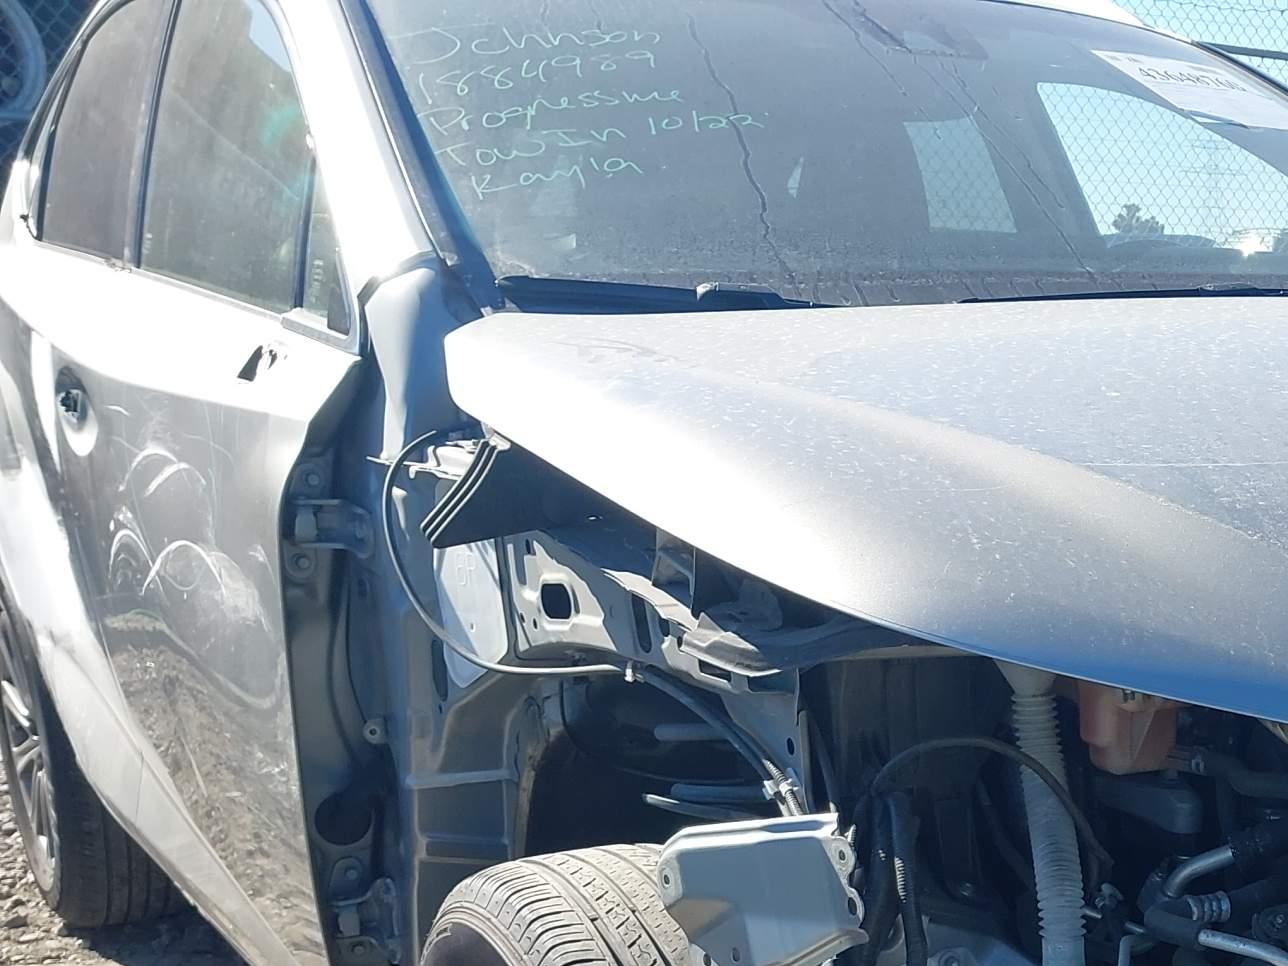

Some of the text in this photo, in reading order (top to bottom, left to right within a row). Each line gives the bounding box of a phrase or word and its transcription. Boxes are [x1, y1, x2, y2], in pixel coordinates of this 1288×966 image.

[417, 49, 656, 104] 1884989
[435, 139, 545, 168] Tow
[648, 111, 766, 136] 10/22
